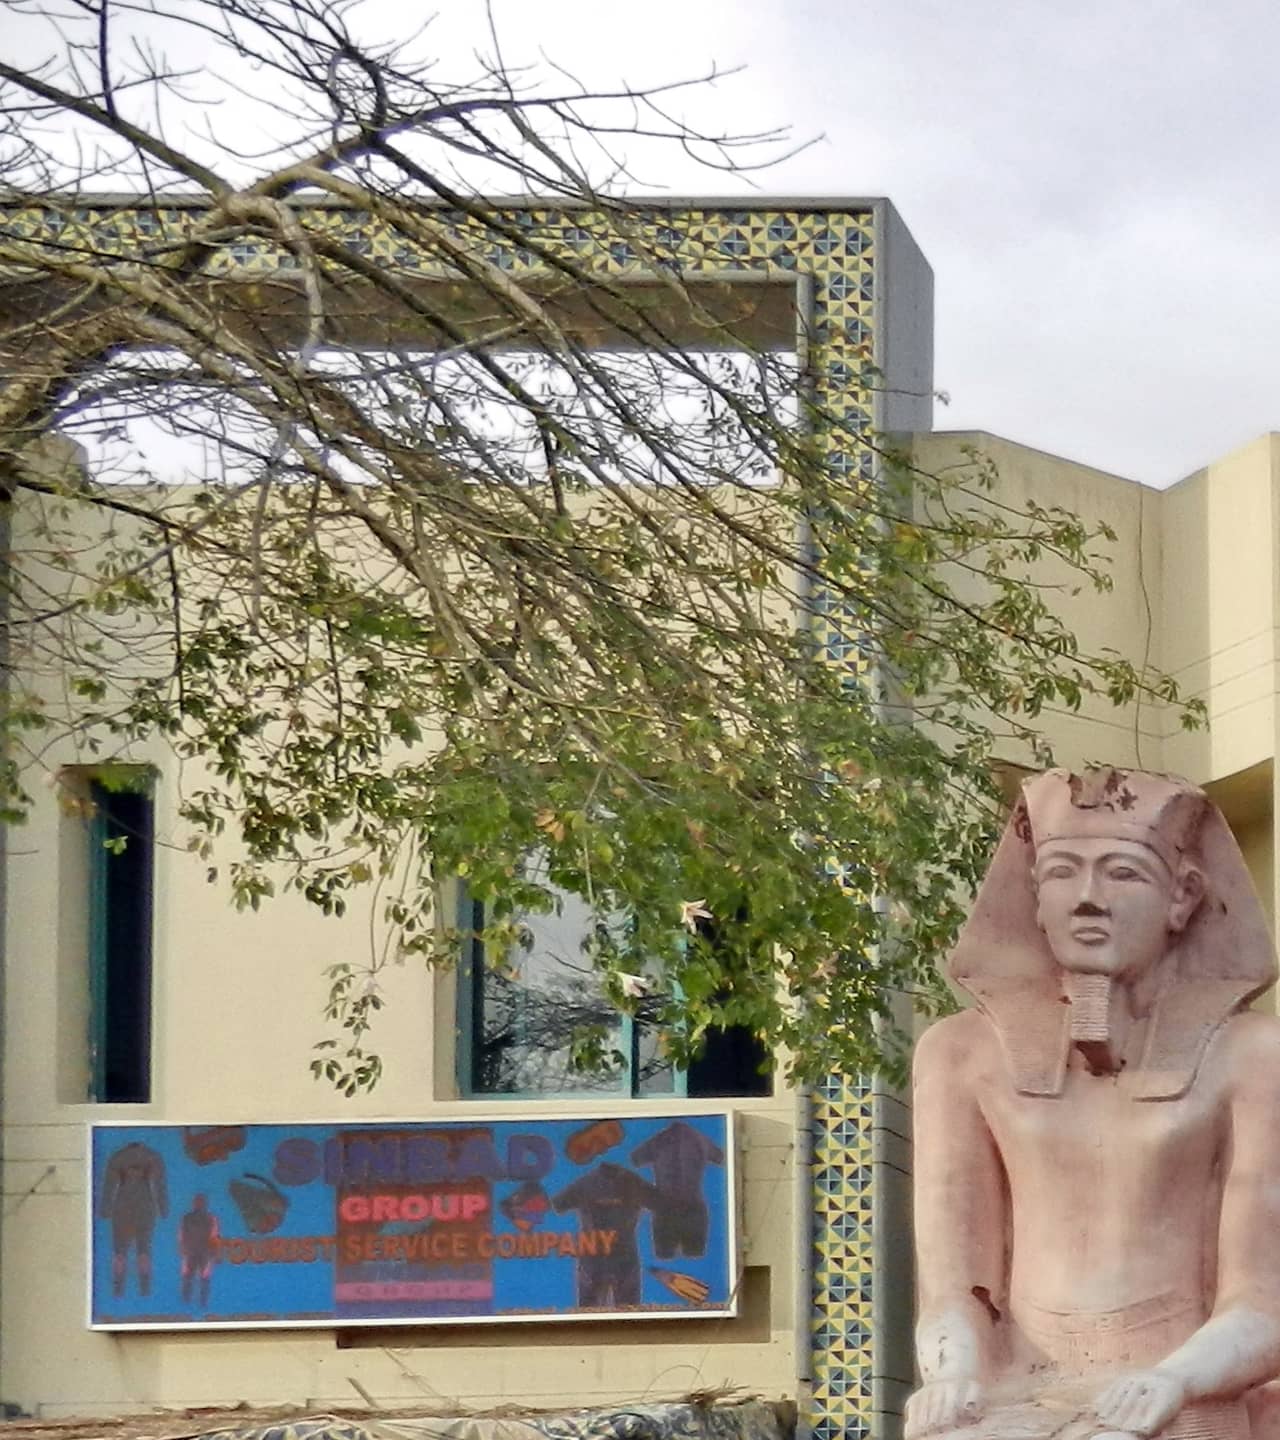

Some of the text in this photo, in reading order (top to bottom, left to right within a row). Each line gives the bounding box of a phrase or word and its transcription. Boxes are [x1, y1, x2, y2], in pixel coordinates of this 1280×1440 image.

[273, 1133, 555, 1186] SINBAD
[340, 1193, 489, 1222] GROUP
[213, 1230, 618, 1265] TOURIST SERVICE COMPANY
